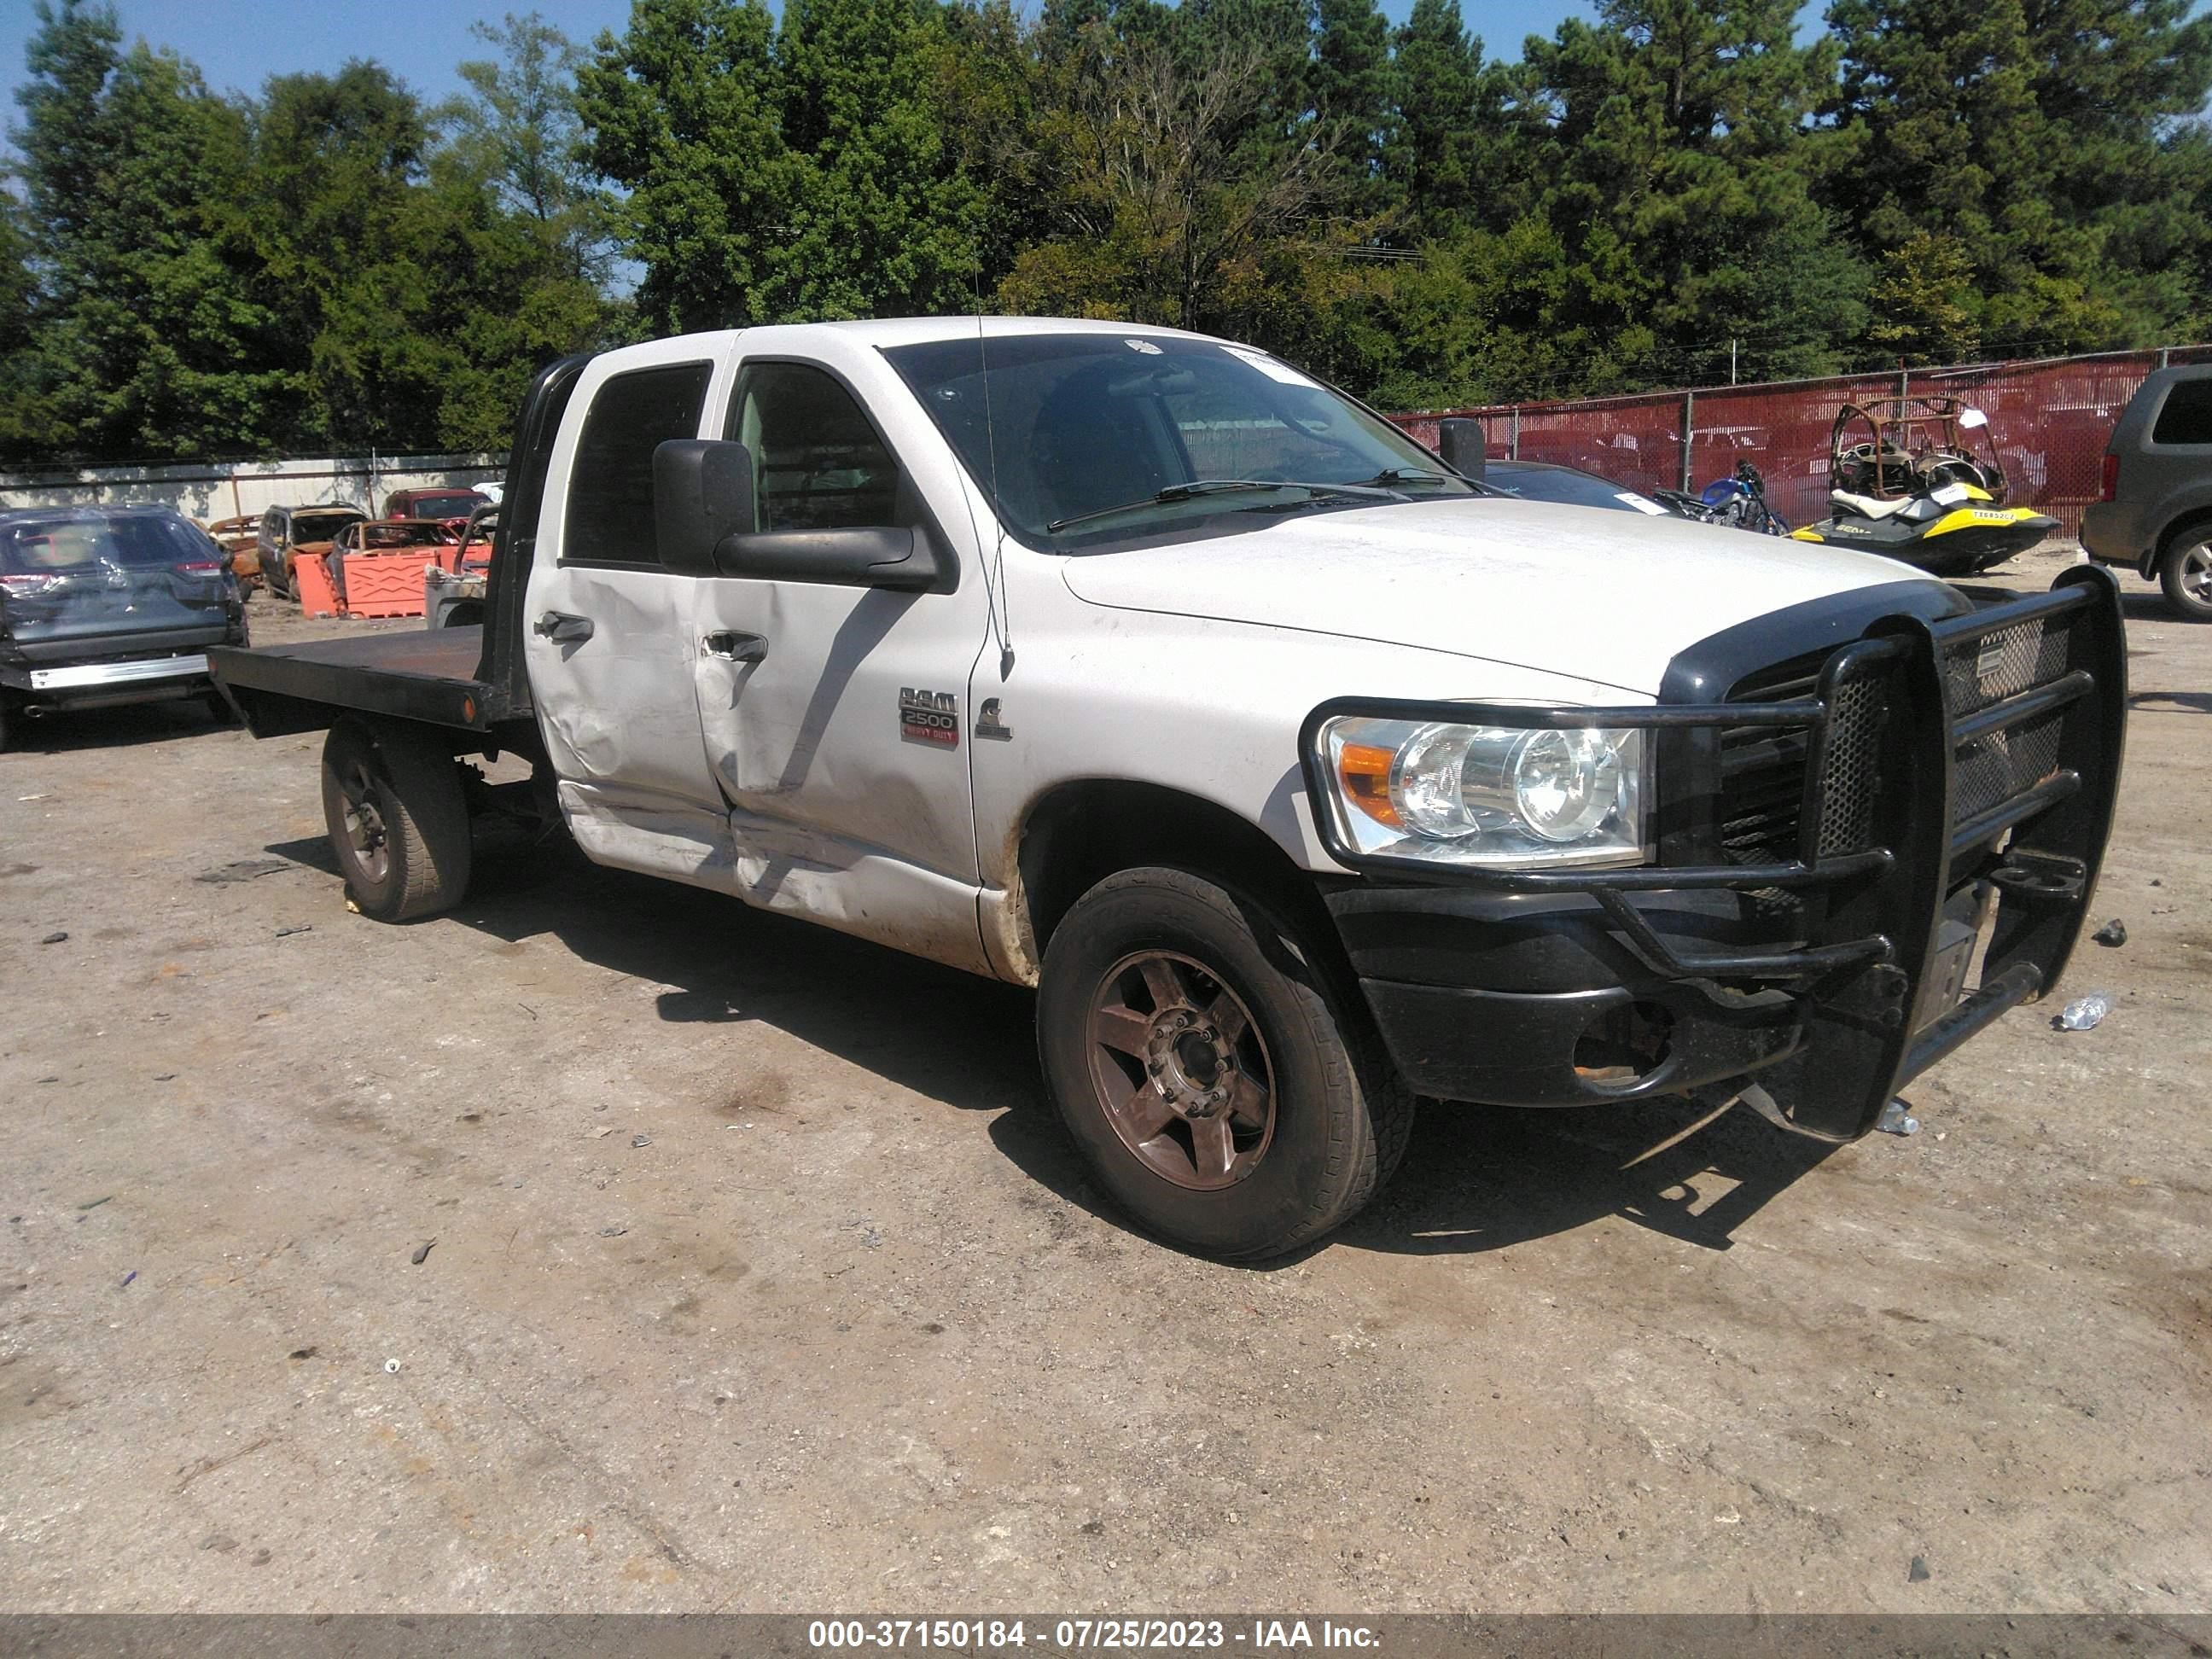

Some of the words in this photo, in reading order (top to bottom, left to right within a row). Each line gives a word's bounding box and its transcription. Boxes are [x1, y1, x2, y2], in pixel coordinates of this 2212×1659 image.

[899, 687, 958, 711] RAM
[905, 710, 953, 729] 2500
[906, 725, 929, 737] HEAVY
[933, 730, 953, 741] DUTY
